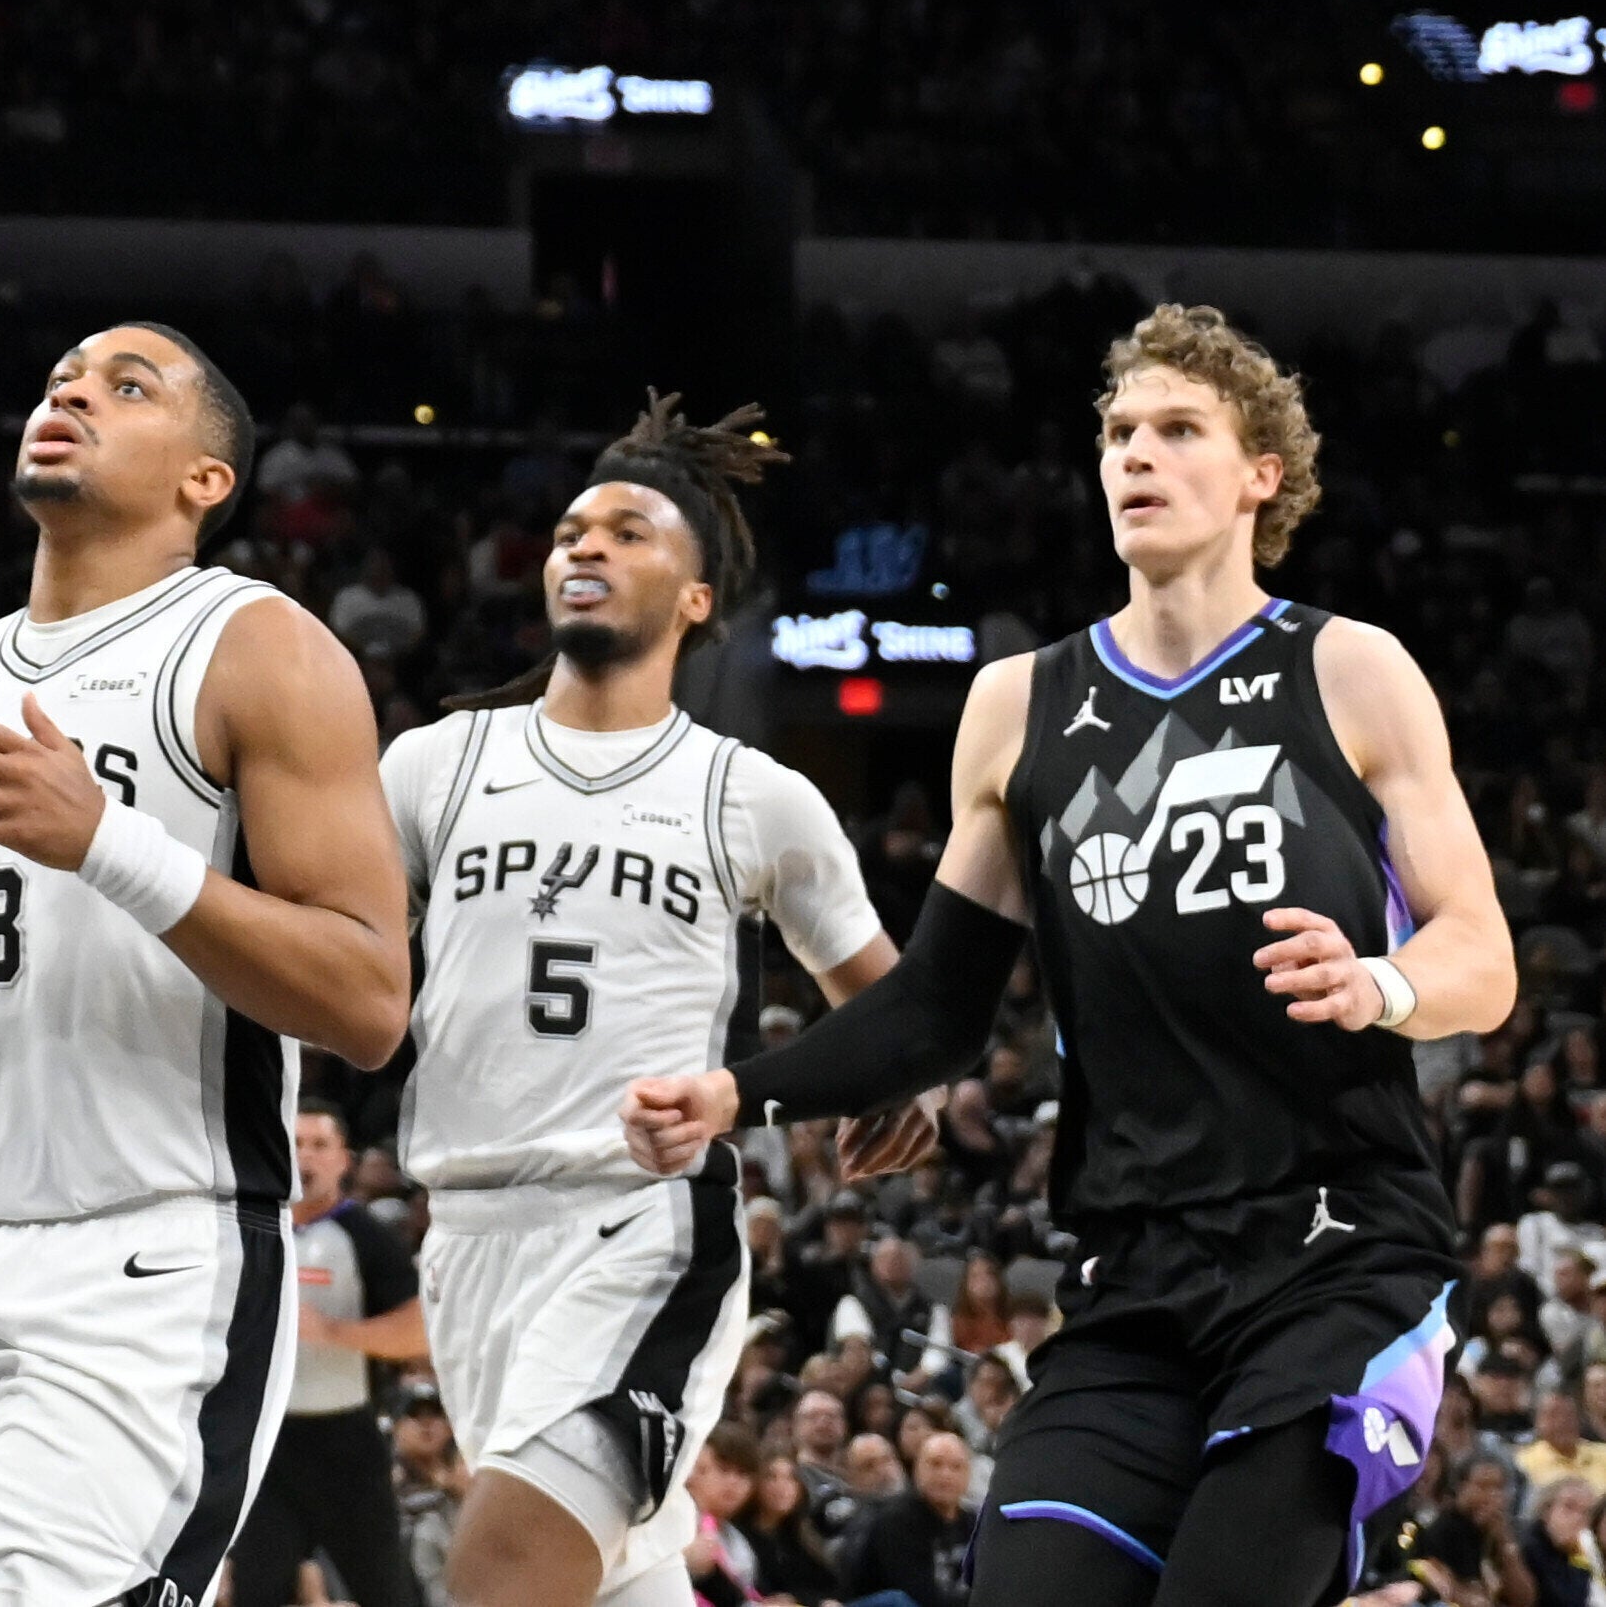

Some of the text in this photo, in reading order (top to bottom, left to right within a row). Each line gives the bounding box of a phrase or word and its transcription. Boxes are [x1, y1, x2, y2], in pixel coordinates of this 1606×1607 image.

[80, 679, 135, 691] LEDGER
[1219, 672, 1282, 705] LVT
[454, 840, 702, 926] SPURS
[1170, 804, 1286, 916] 23
[525, 935, 599, 1041] 5
